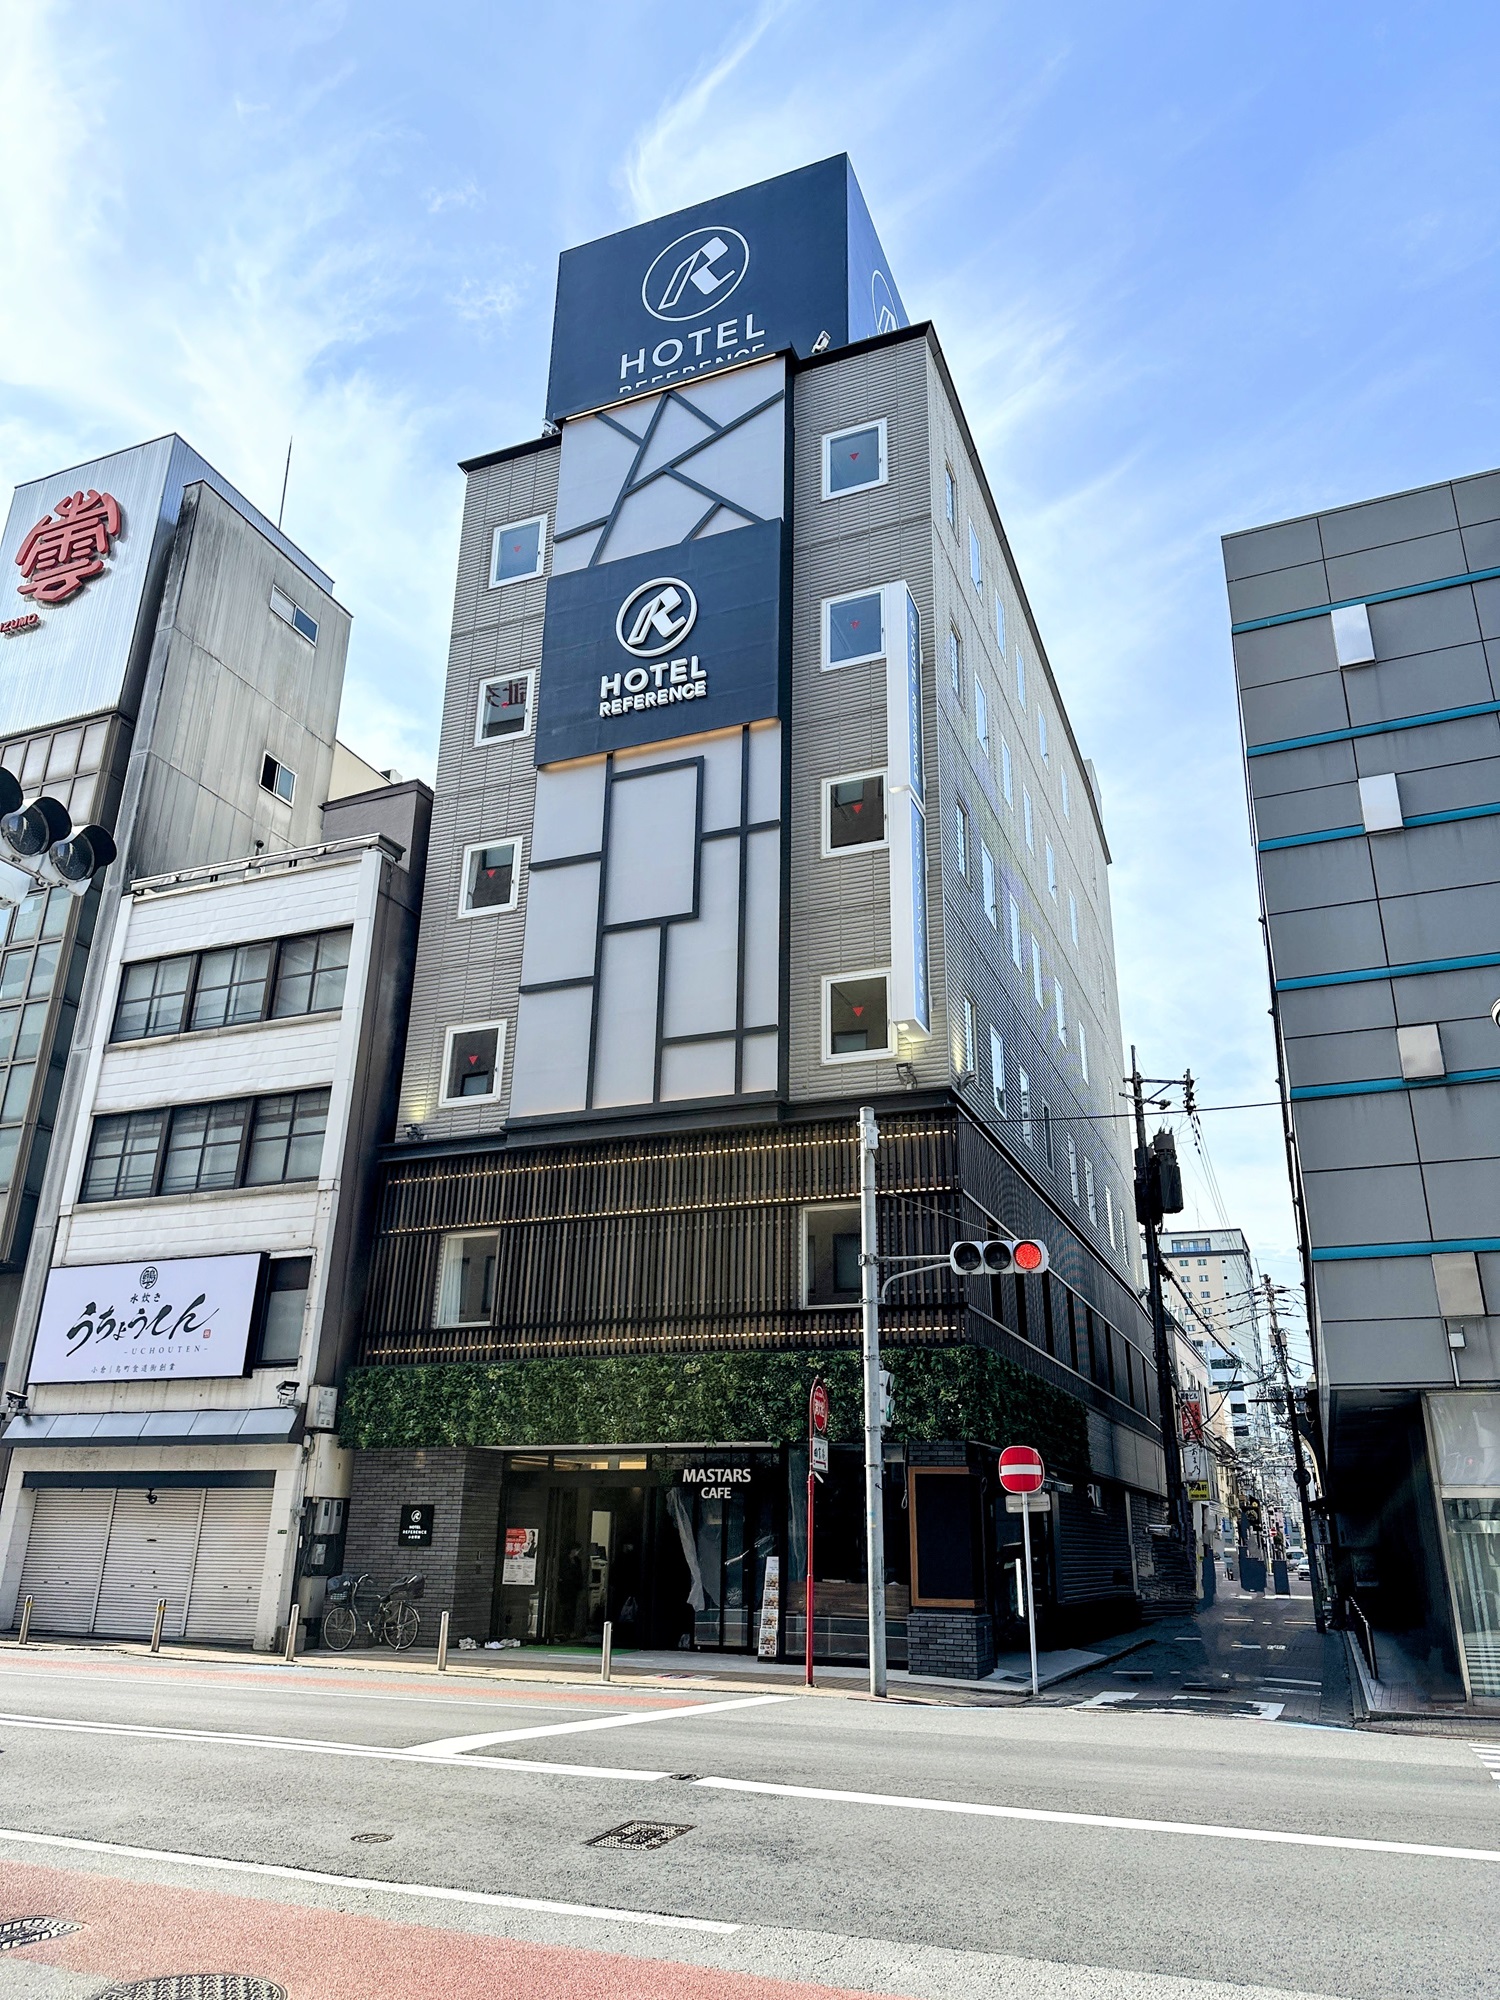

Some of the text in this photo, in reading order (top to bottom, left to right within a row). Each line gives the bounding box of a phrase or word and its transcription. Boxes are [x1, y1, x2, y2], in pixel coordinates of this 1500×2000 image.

[620, 313, 765, 379] HOTEL
[600, 655, 707, 699] HOTEL
[599, 680, 707, 718] REFERENCE
[911, 690, 919, 785] REFERENCE
[130, 1292, 161, 1304] 水炊き
[682, 1468, 752, 1483] MASTARS
[701, 1487, 732, 1499] CAFE
